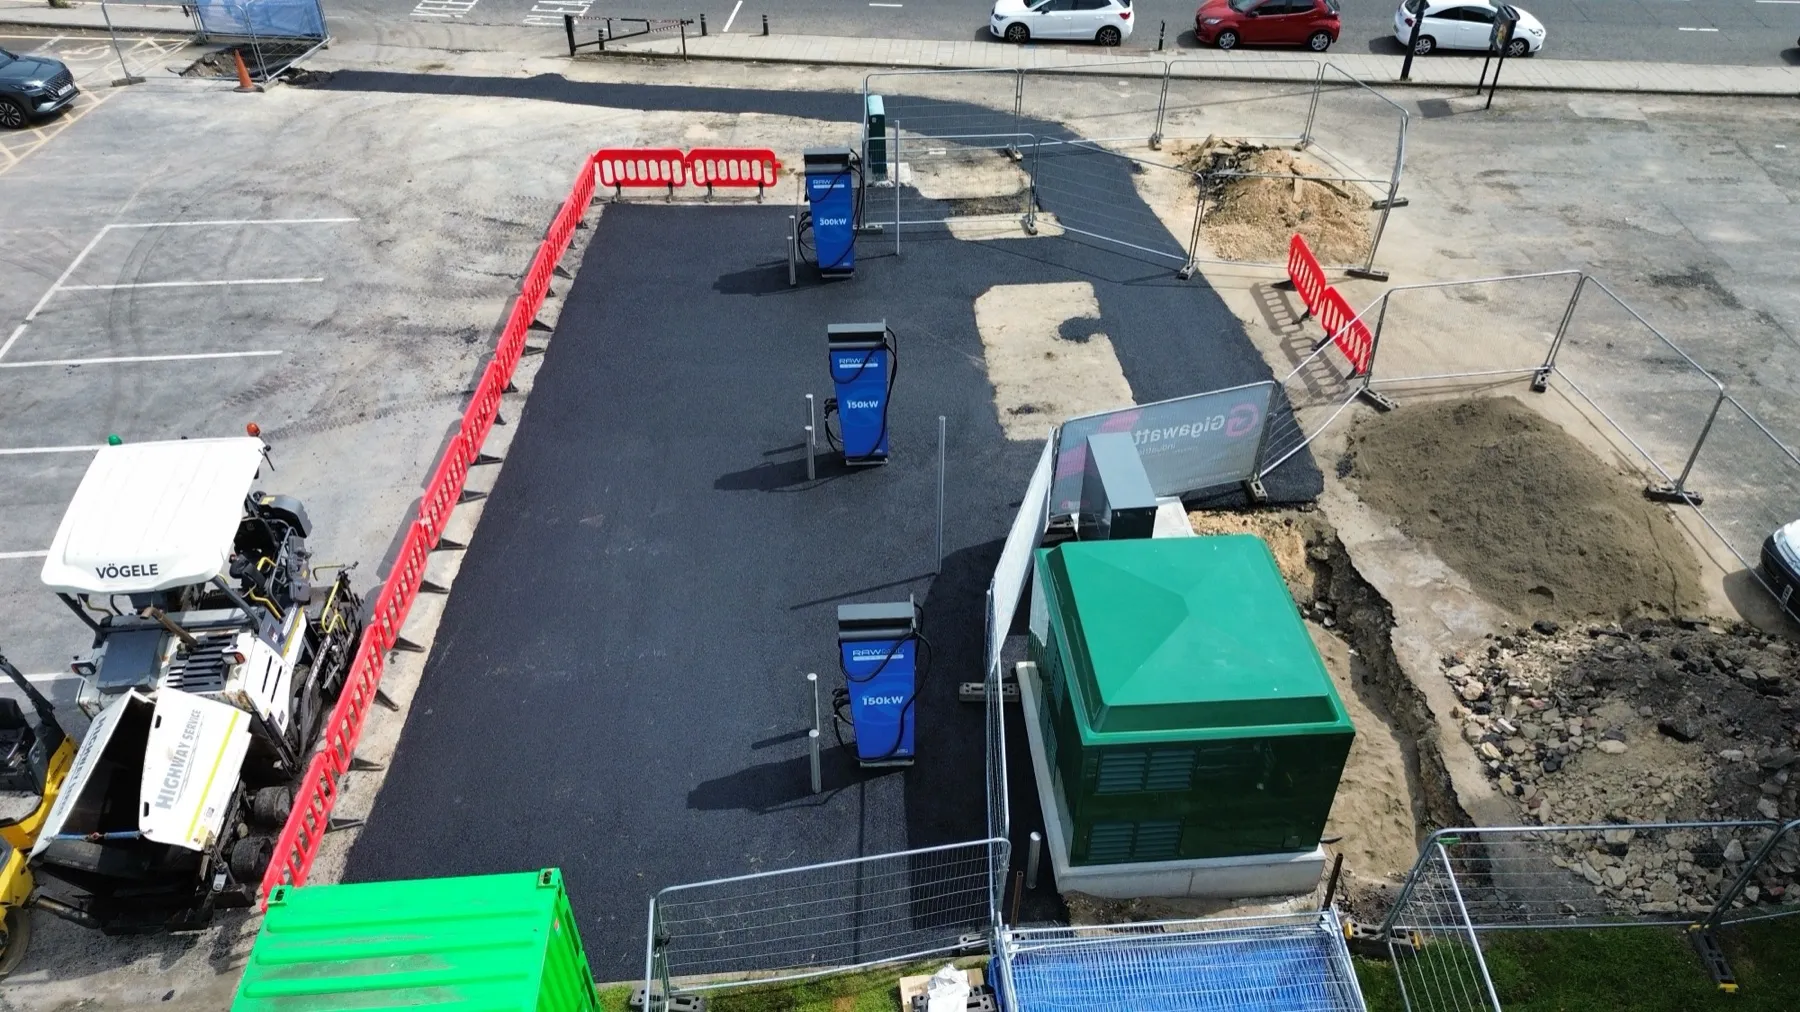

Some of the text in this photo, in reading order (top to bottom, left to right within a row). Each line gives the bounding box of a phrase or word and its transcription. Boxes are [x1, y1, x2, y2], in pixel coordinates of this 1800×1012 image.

[819, 218, 847, 226] 300kW
[847, 400, 879, 409] 150kW
[95, 562, 160, 579] VÖGELE
[861, 695, 904, 706] 150kW
[154, 708, 202, 810] HIGHWAY SERVICE
